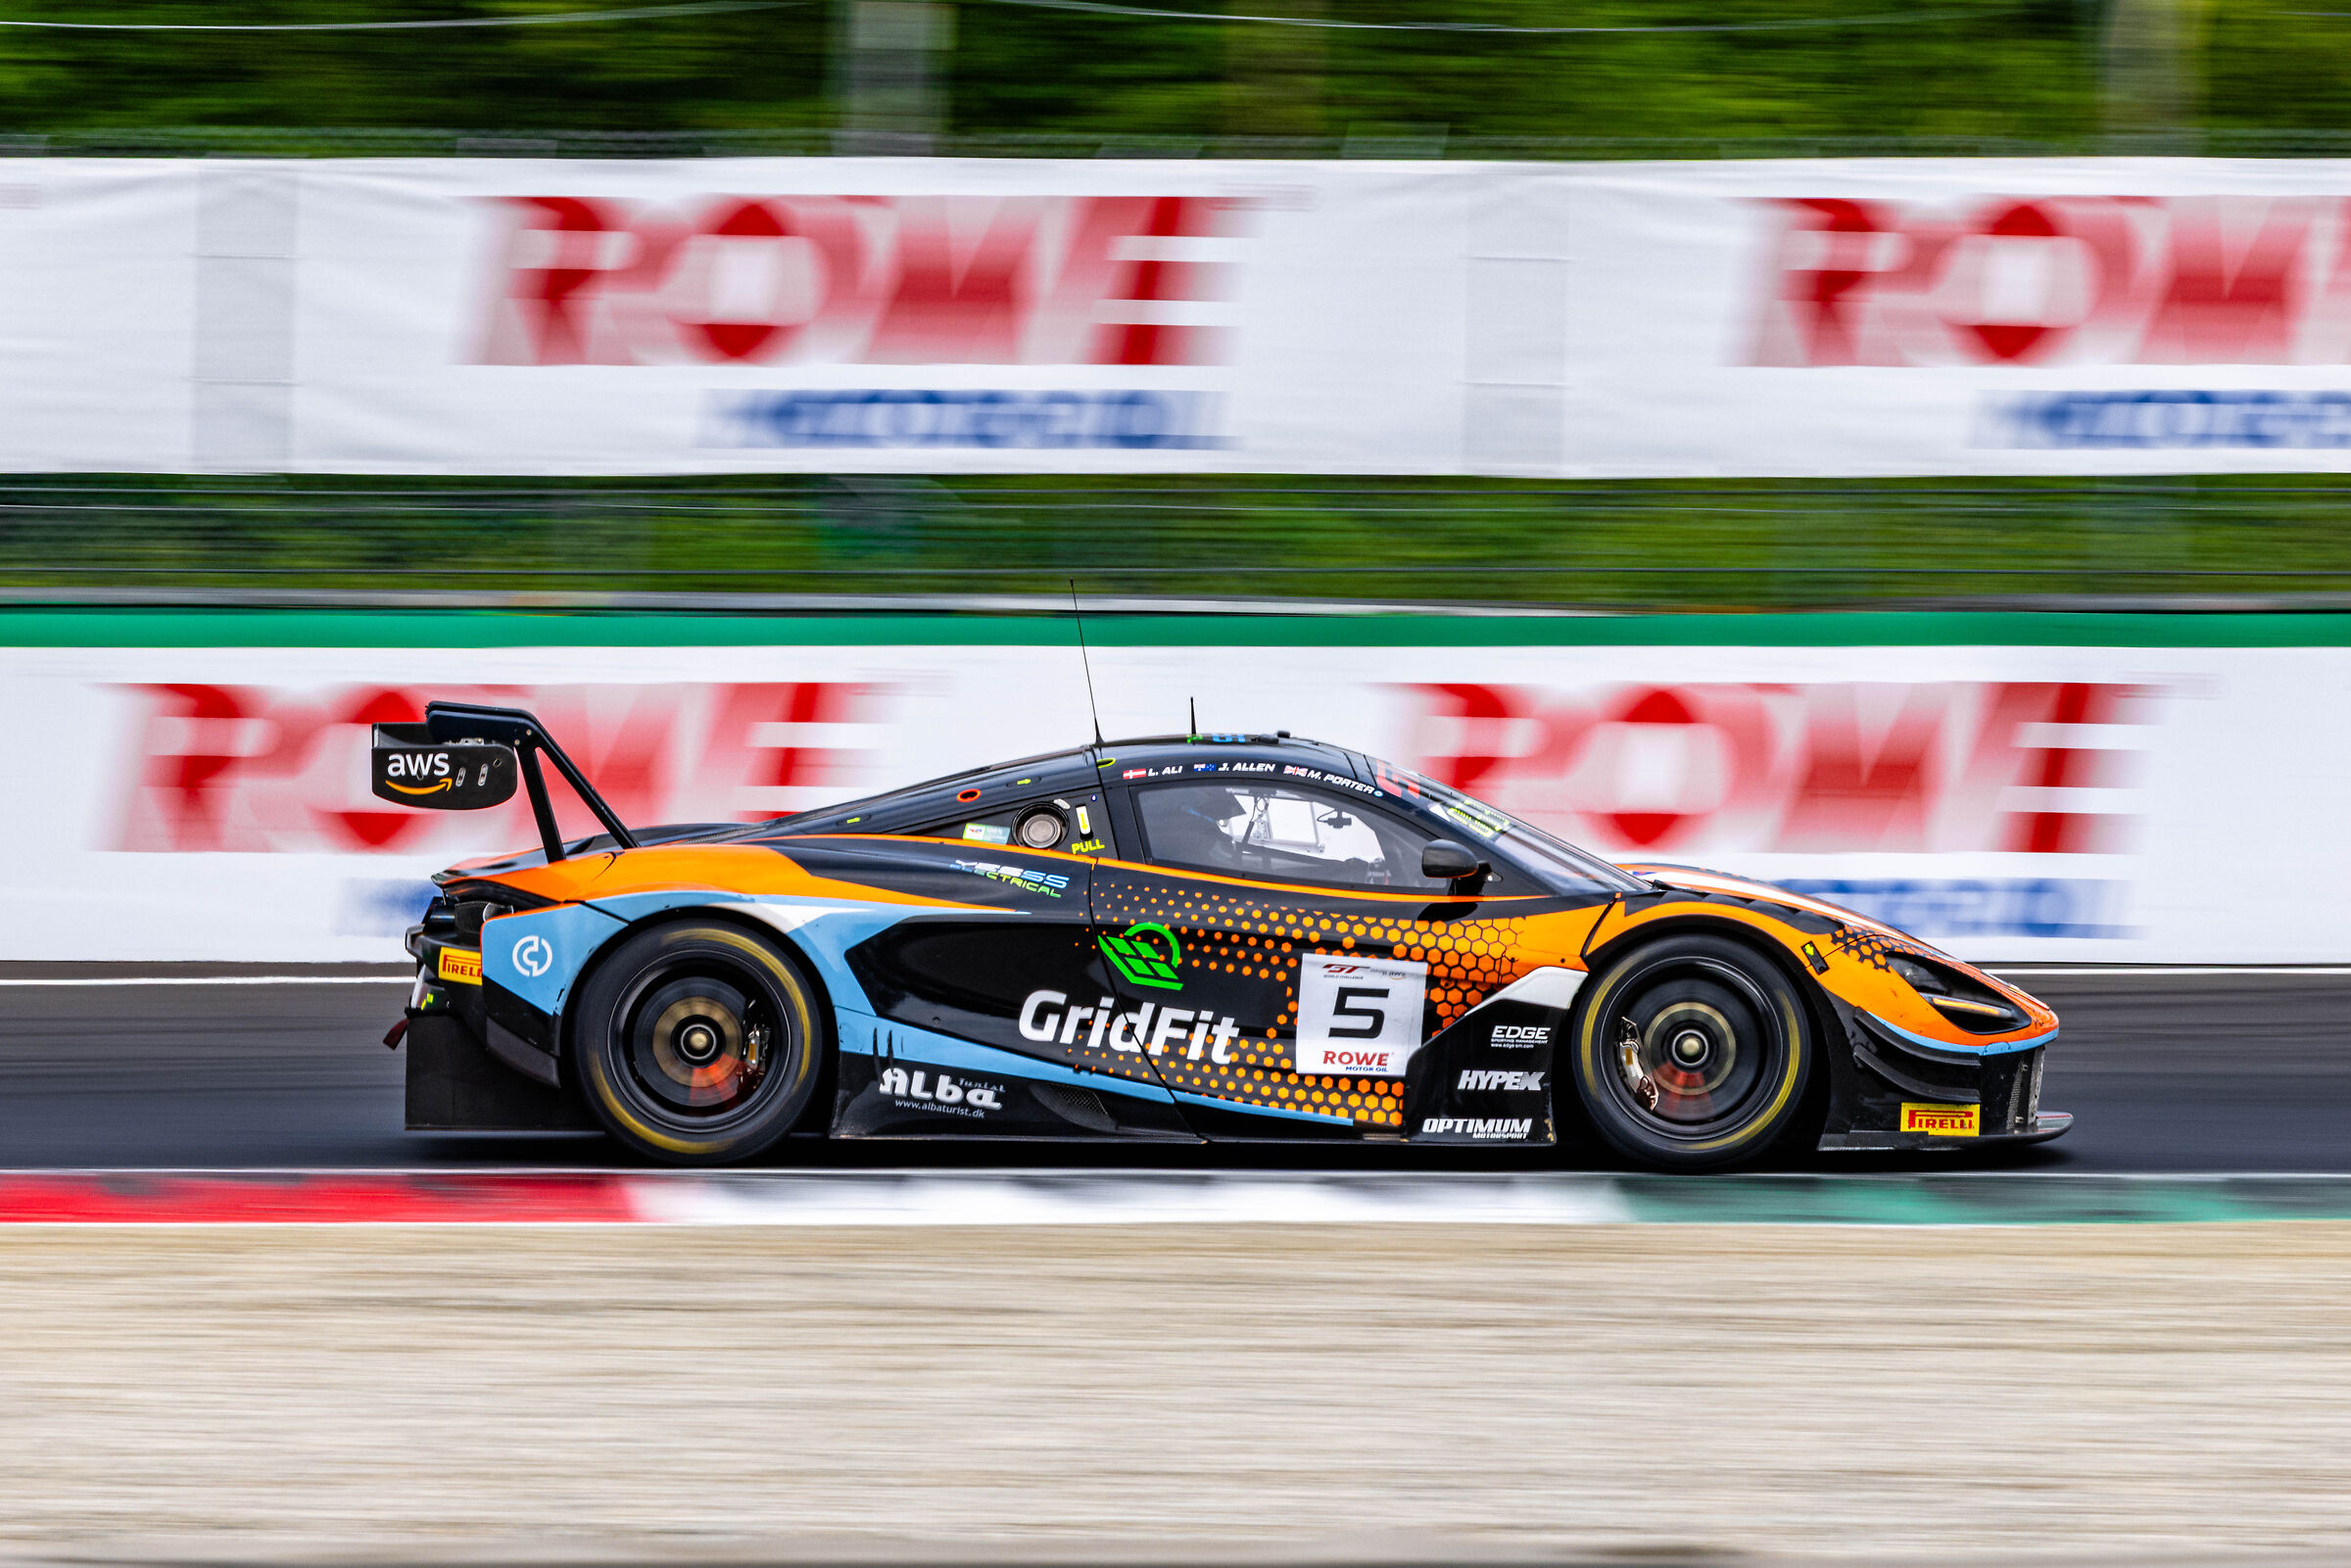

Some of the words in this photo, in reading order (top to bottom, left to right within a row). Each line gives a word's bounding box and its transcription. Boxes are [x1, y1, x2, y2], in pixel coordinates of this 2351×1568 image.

[468, 196, 1244, 365] ROWE
[387, 752, 451, 777] aws
[1147, 768, 1159, 778] L.
[1162, 765, 1183, 776] ALI
[1218, 762, 1229, 772] J.
[1232, 762, 1276, 773] ALLEN
[1307, 770, 1321, 781] M.
[1323, 773, 1375, 794] PORTER
[1071, 838, 1105, 855] PULL
[1327, 986, 1390, 1039] 5
[1018, 988, 1240, 1065] GridFit
[1491, 1024, 1551, 1040] EDGE
[1322, 1050, 1390, 1067] ROWE
[1457, 1069, 1546, 1091] HYPEX
[894, 1099, 985, 1118] www.albaturist.dk
[1421, 1117, 1533, 1133] OPTIMUM
[1907, 1109, 1974, 1129] PIRELLI
